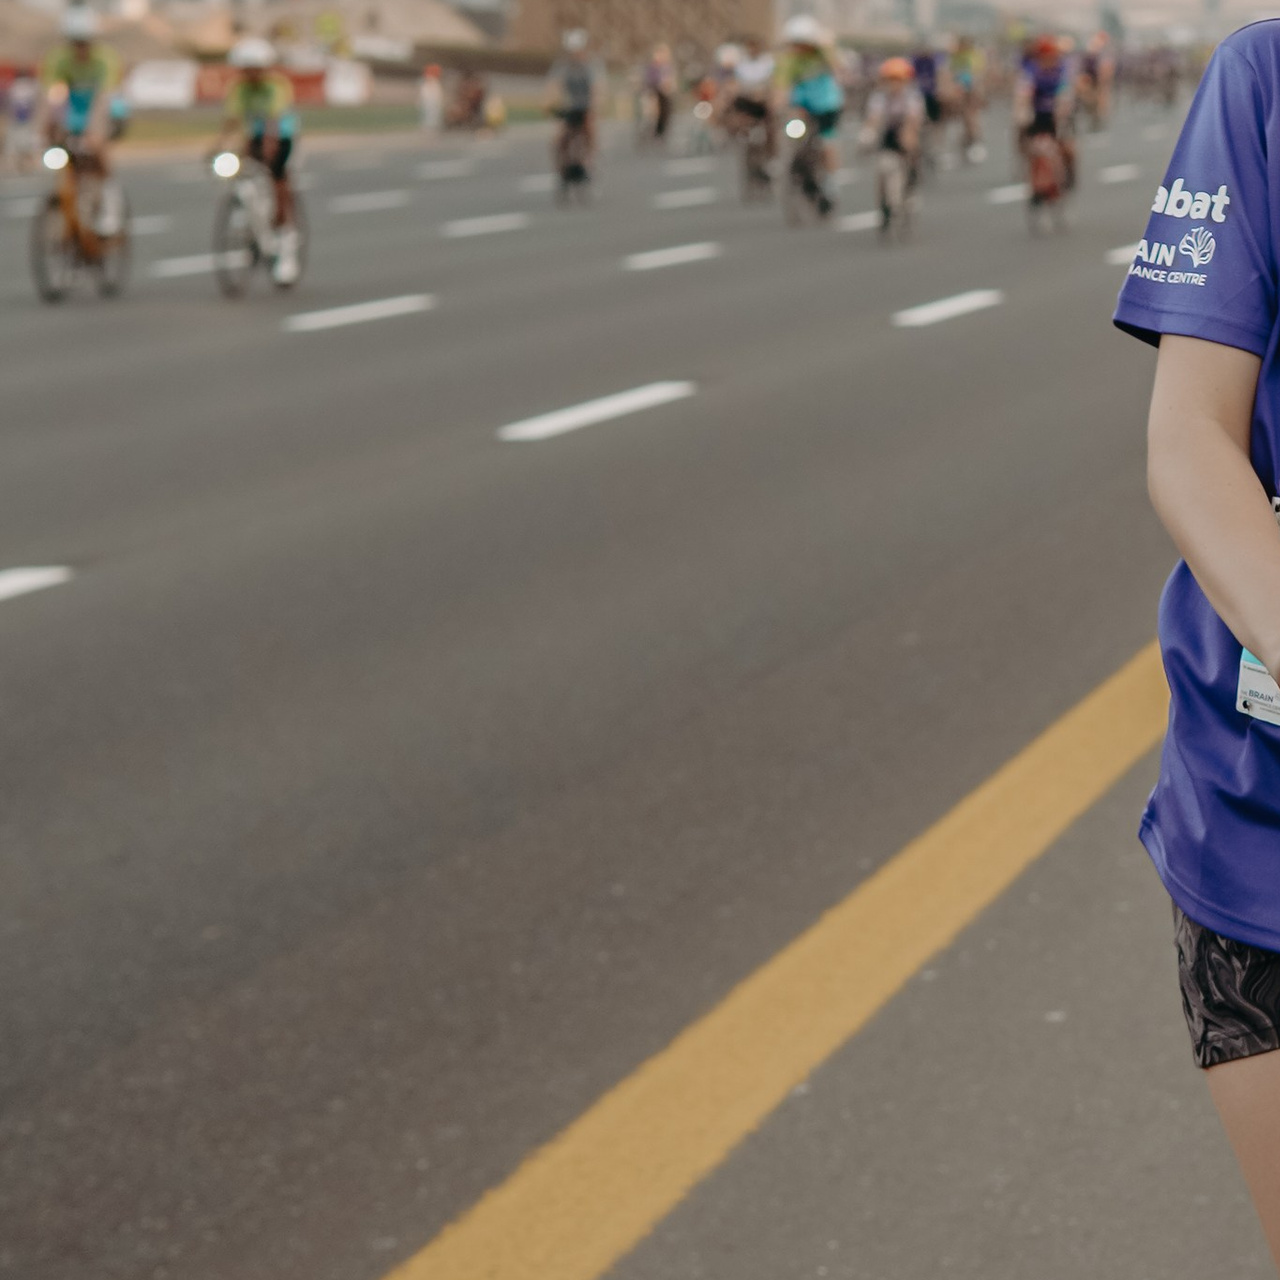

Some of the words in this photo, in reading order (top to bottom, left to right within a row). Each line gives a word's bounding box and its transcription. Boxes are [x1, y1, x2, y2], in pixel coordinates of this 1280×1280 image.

[1151, 178, 1230, 223] abat
[1136, 238, 1176, 267] AIN
[1129, 263, 1167, 282] ANCE
[1167, 271, 1207, 286] CENTRE
[1248, 689, 1274, 704] BRAIN
